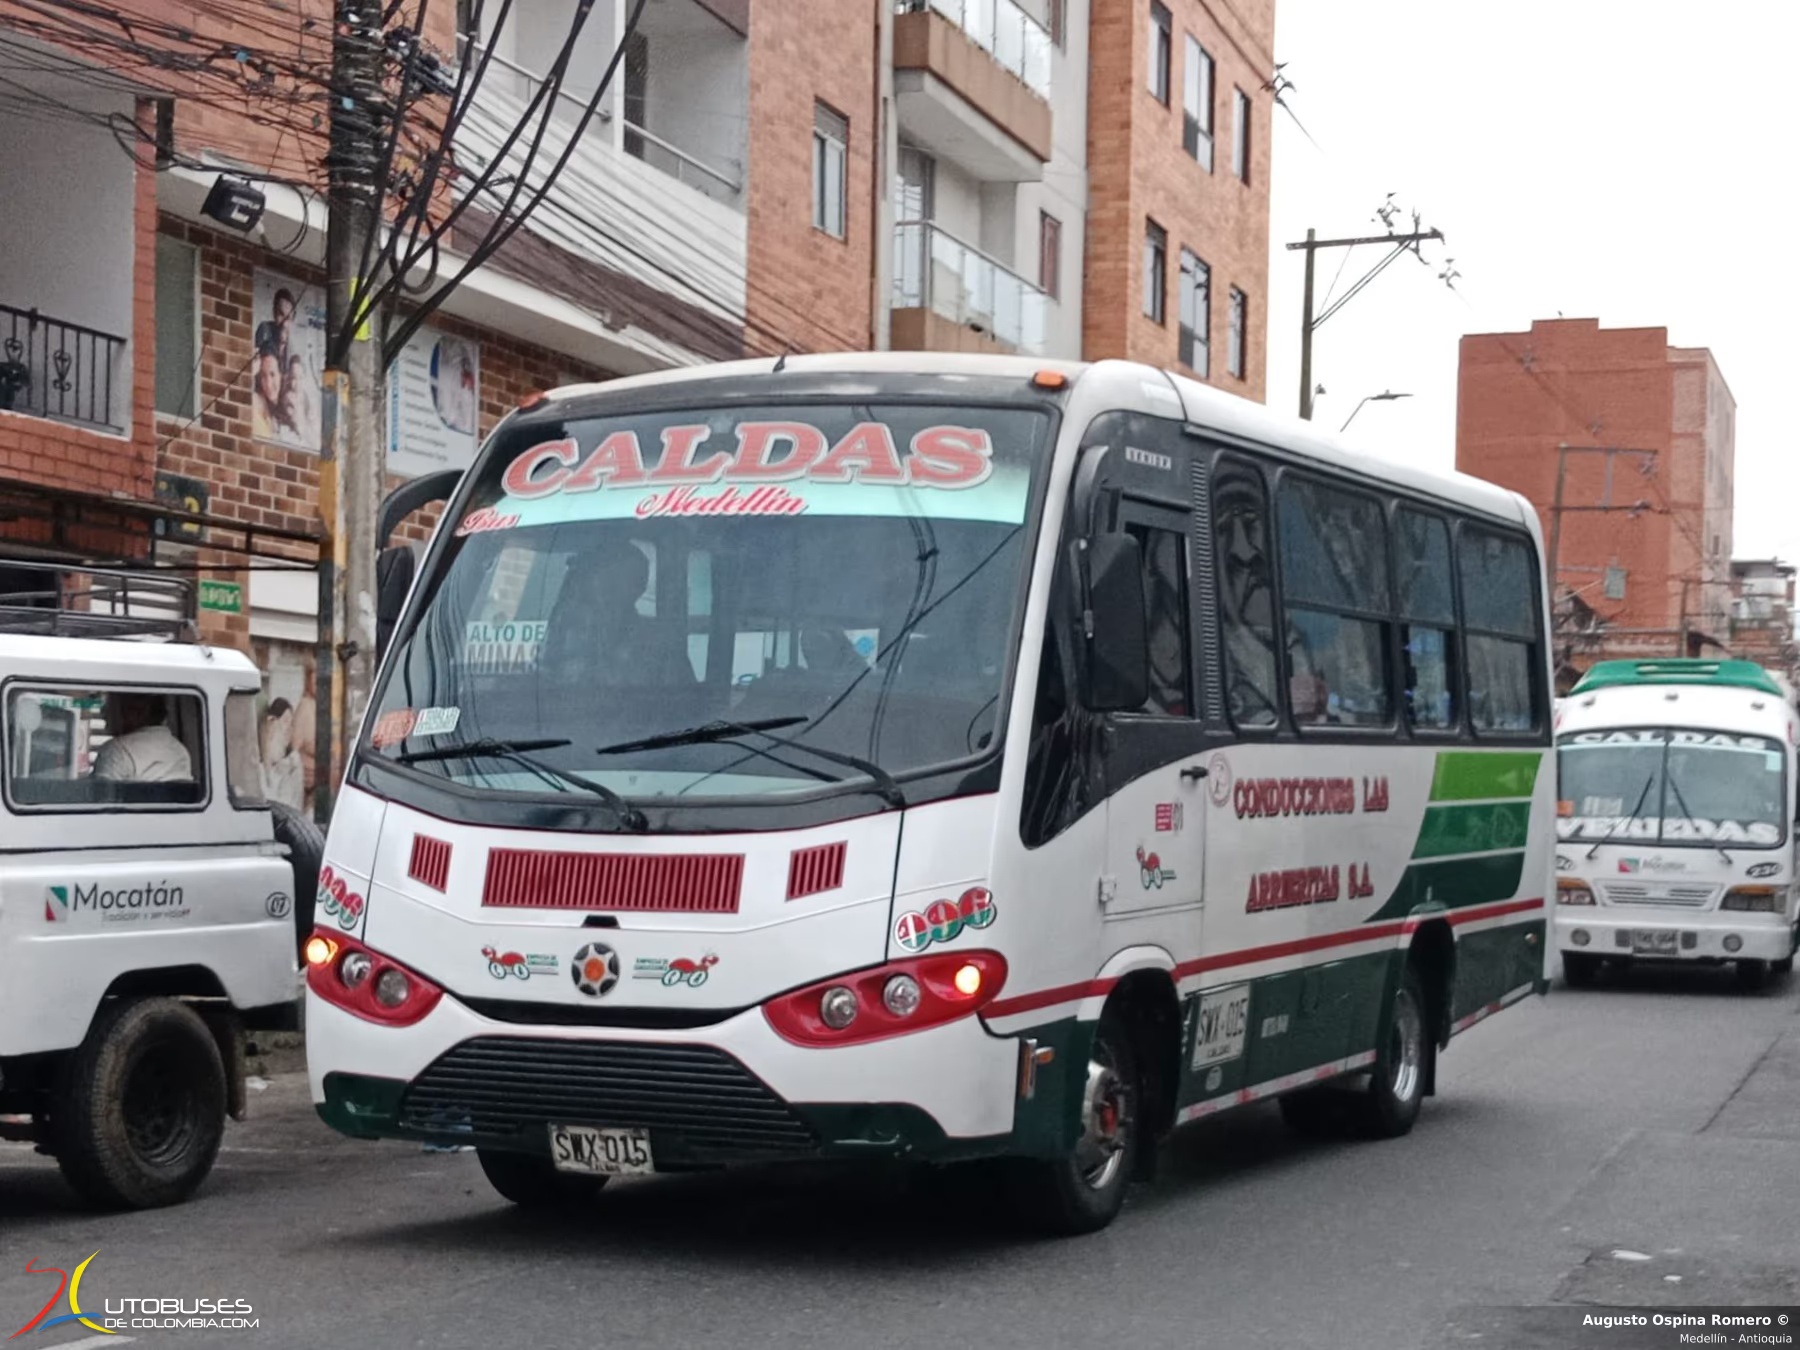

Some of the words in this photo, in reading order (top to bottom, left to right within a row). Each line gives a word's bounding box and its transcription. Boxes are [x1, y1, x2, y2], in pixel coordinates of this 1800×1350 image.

[502, 421, 993, 499] CALDAS
[469, 623, 517, 643] ALTO
[521, 624, 546, 643] DE
[1574, 731, 1767, 750] CALDAS
[1362, 775, 1390, 812] LAS
[73, 879, 184, 911] Mocatán
